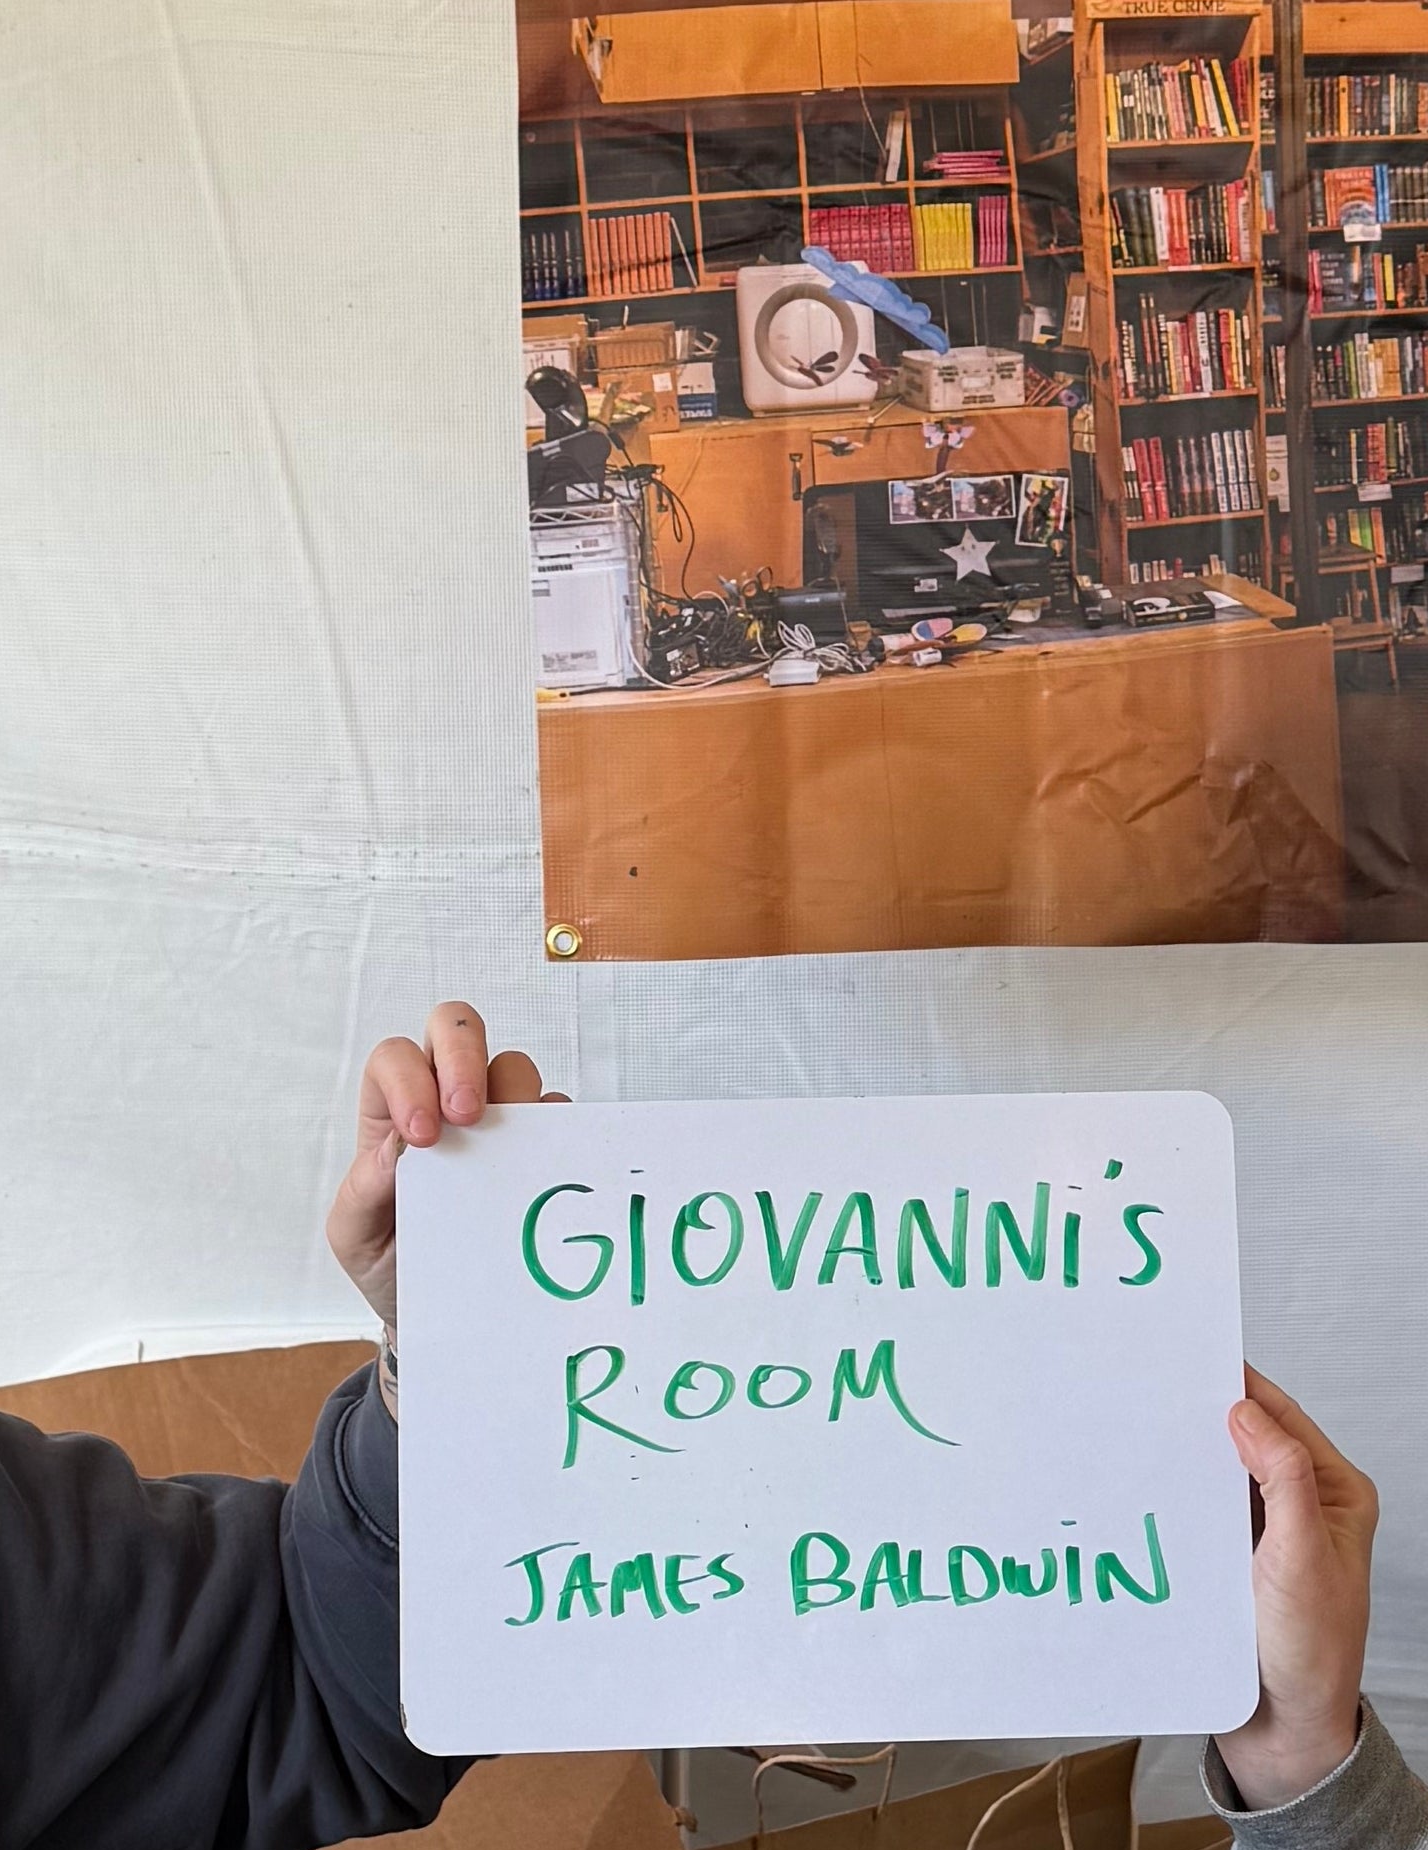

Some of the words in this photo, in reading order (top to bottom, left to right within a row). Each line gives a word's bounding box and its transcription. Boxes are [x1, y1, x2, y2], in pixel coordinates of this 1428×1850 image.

[1124, 1, 1168, 14] TRUE
[1173, 0, 1225, 13] CRIME
[562, 1339, 962, 1470] ROOM
[504, 1541, 746, 1627] JAMES
